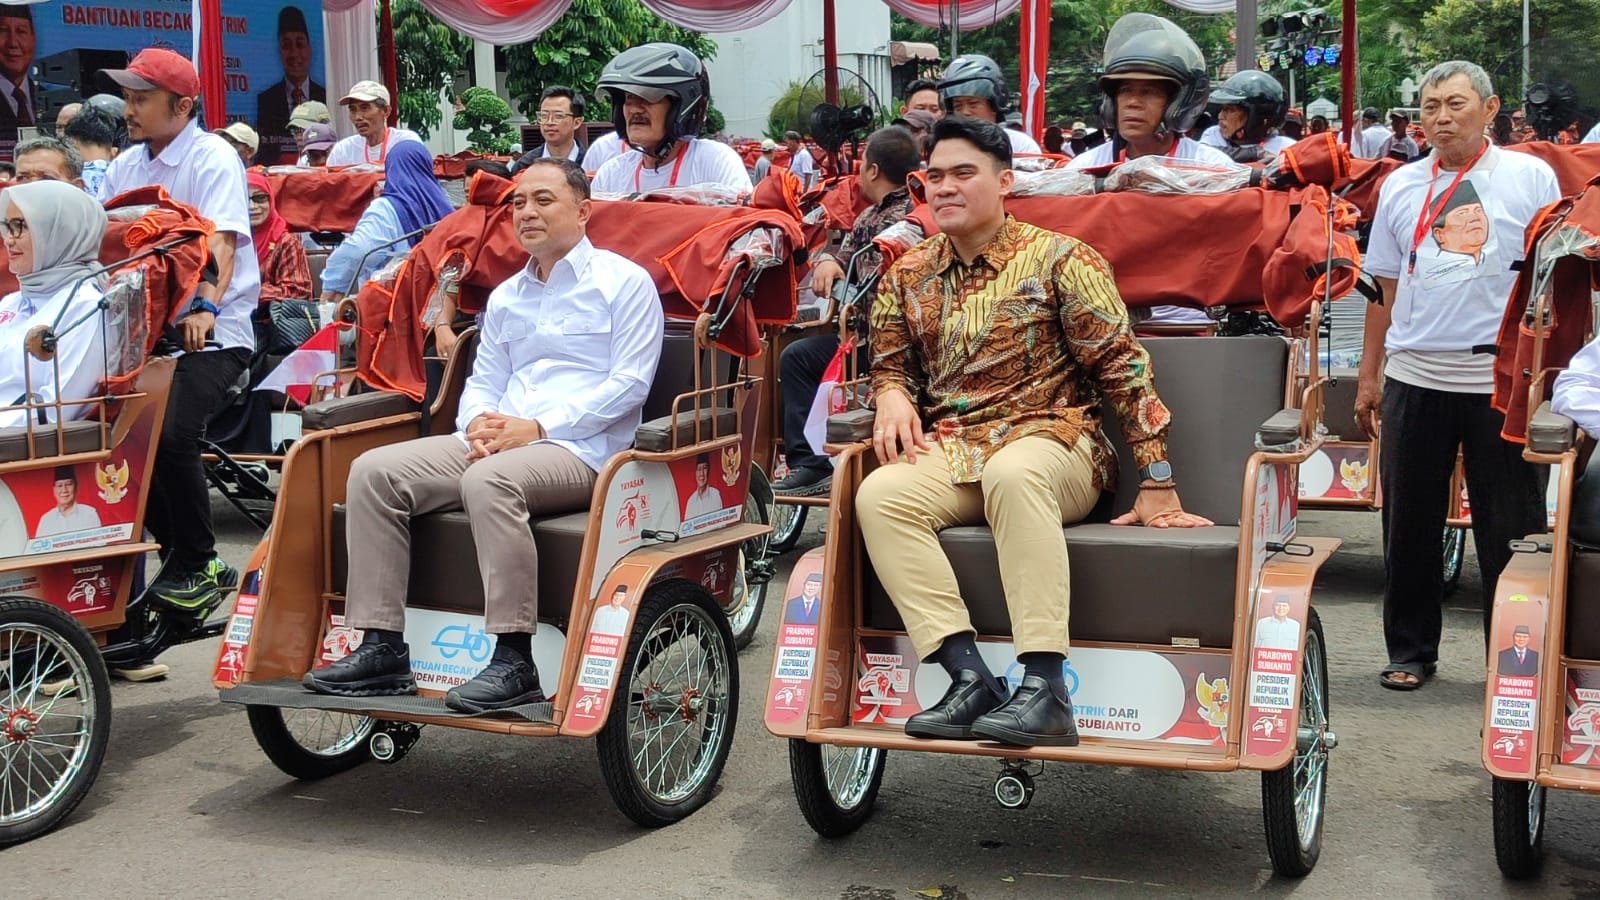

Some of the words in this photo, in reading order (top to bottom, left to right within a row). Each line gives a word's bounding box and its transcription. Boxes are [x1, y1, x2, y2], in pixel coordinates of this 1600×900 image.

[62, 5, 141, 28] BANTUAN
[144, 10, 193, 31] BECAK
[621, 478, 644, 491] YAYASAN
[785, 626, 815, 636] PRABOWO
[783, 649, 811, 658] PRESIDEN
[1258, 650, 1293, 661] PRABOWO
[781, 658, 809, 667] REPUBLIK
[869, 655, 900, 663] YAYASAN
[410, 659, 441, 672] NTUAN
[442, 663, 473, 675] BECAK
[1257, 660, 1291, 671] SUBIANTO
[778, 668, 809, 677] INDONESIA
[413, 671, 434, 682] IDEN
[436, 675, 470, 686] PRABO
[1257, 674, 1289, 685] PRESIDEN
[1499, 677, 1534, 687] PRABOWO
[1256, 685, 1289, 695] REPUBLIK
[1498, 687, 1532, 696] SUBIANTO
[1579, 690, 1600, 699] YAYA
[1253, 695, 1289, 706] INDONESIA
[1498, 699, 1530, 709] PRESIDEN
[1072, 705, 1105, 716] STRIK
[1109, 707, 1138, 719] DARI
[1497, 708, 1529, 718] REPUBLIK
[1078, 719, 1141, 732] SUBIANTO
[1494, 717, 1530, 728] INDONESIA
